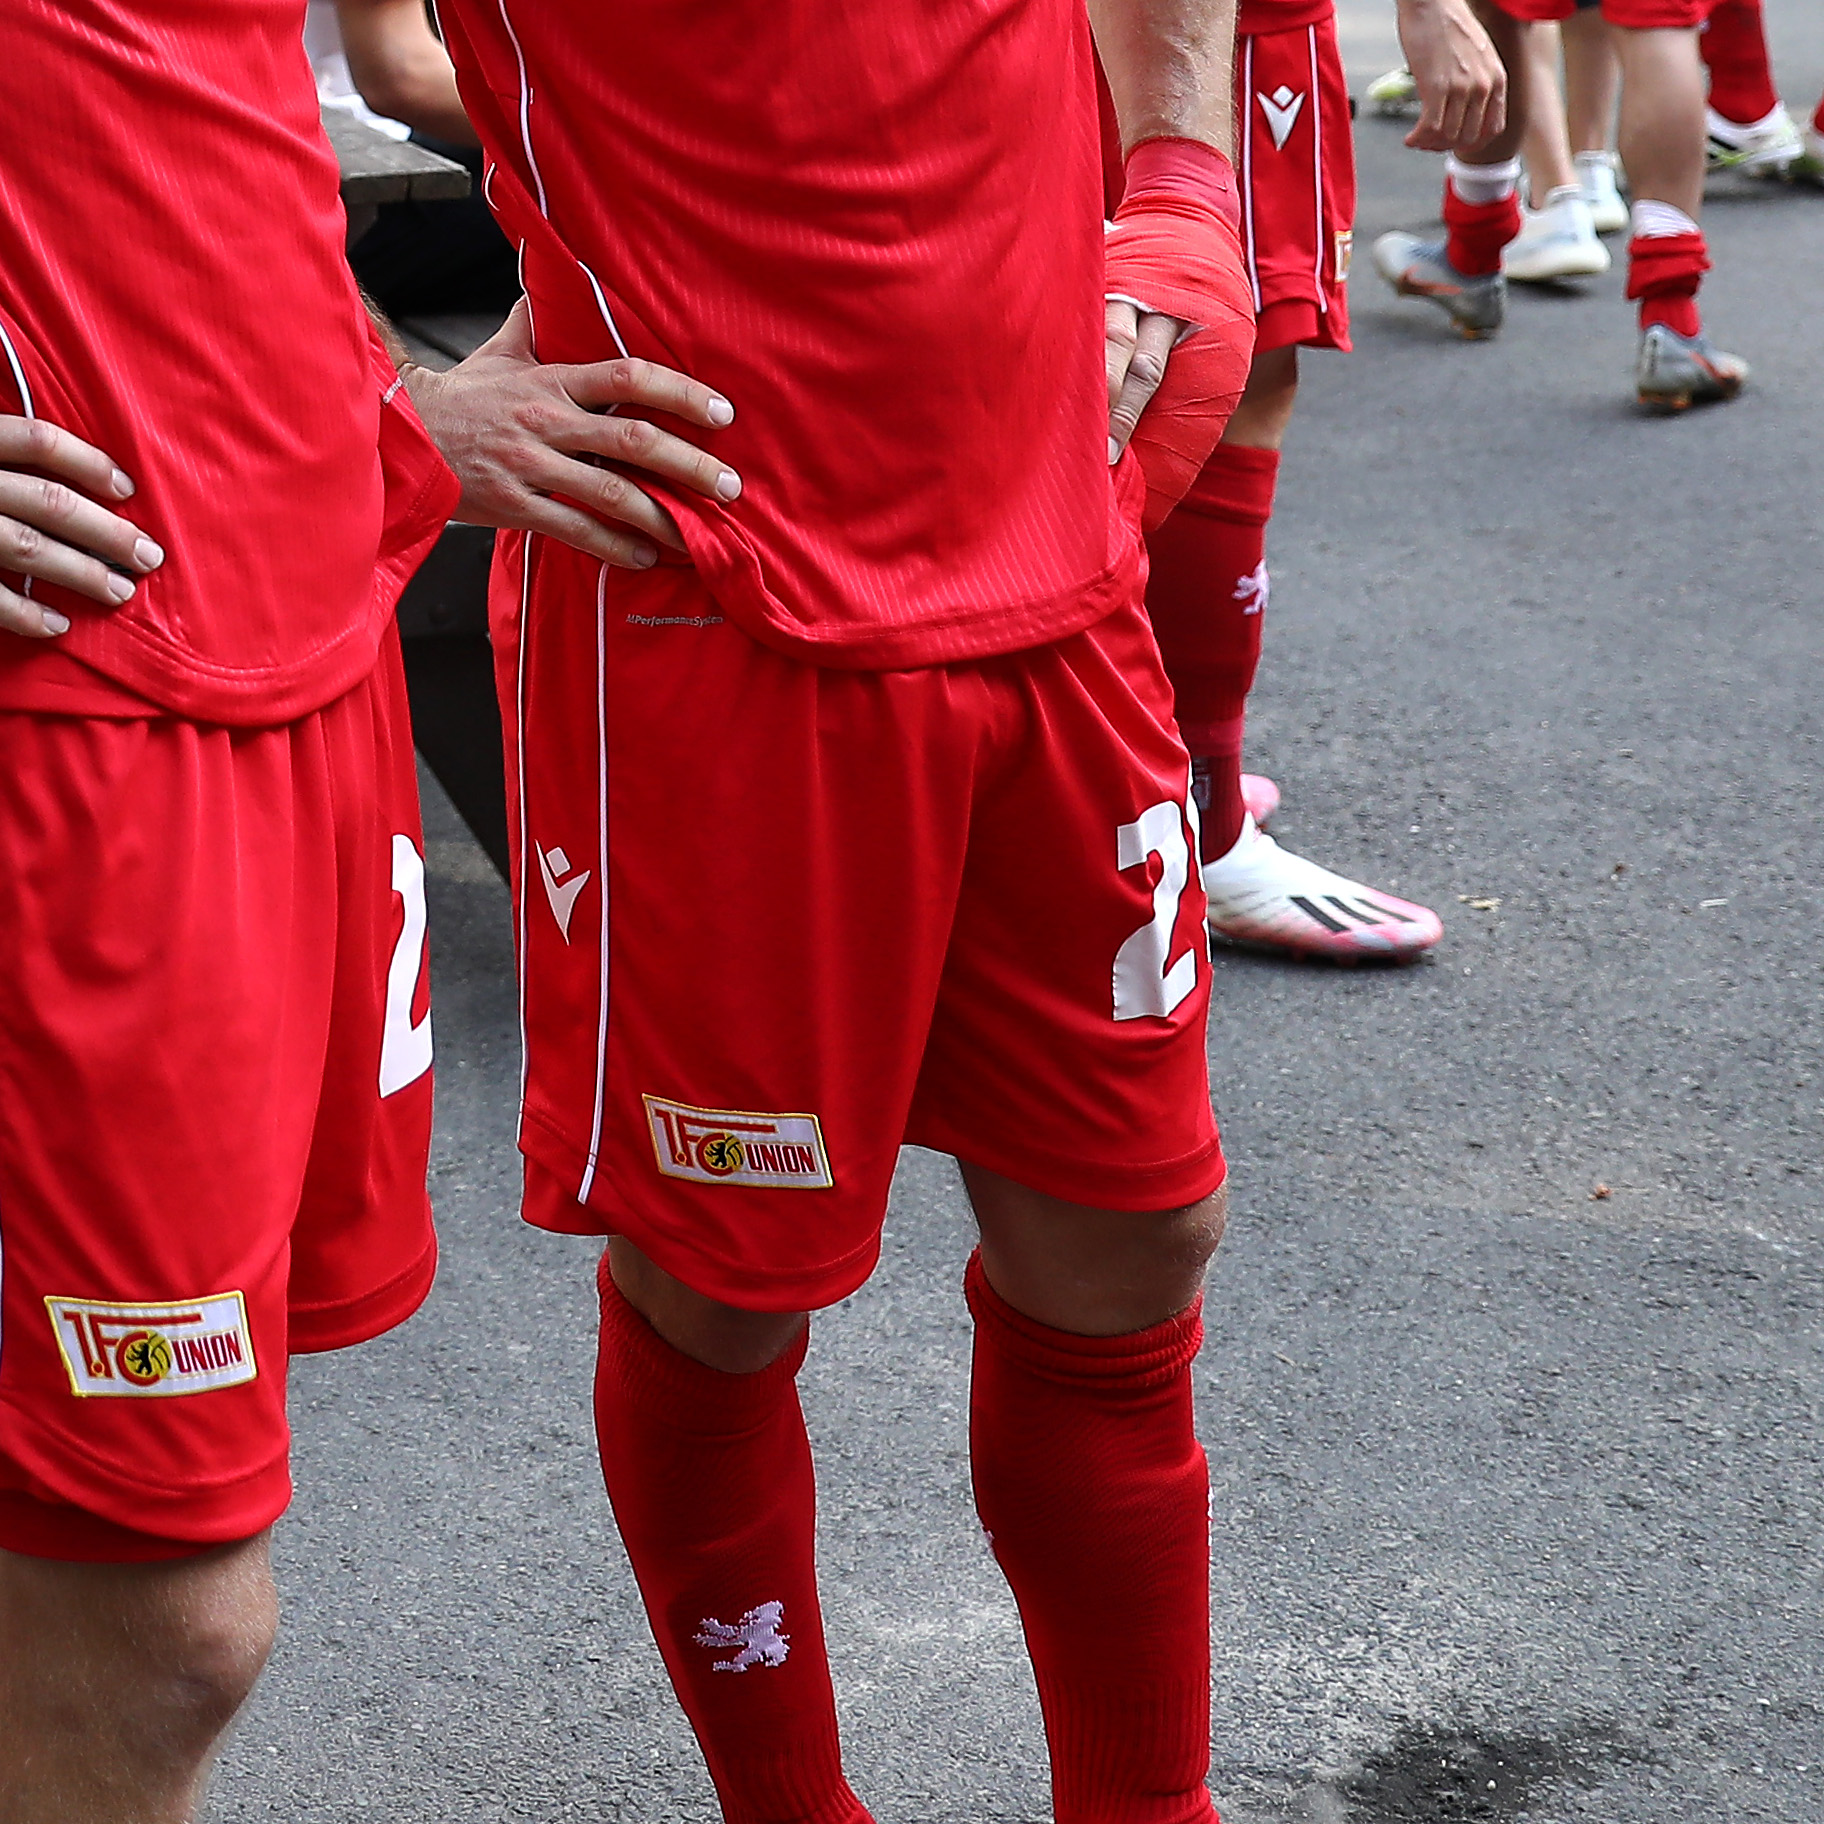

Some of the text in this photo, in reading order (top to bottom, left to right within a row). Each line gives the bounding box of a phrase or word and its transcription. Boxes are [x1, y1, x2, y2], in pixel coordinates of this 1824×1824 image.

[1113, 800, 1212, 1022] 2
[746, 1143, 817, 1173] UNION
[172, 1330, 242, 1374] UNION
